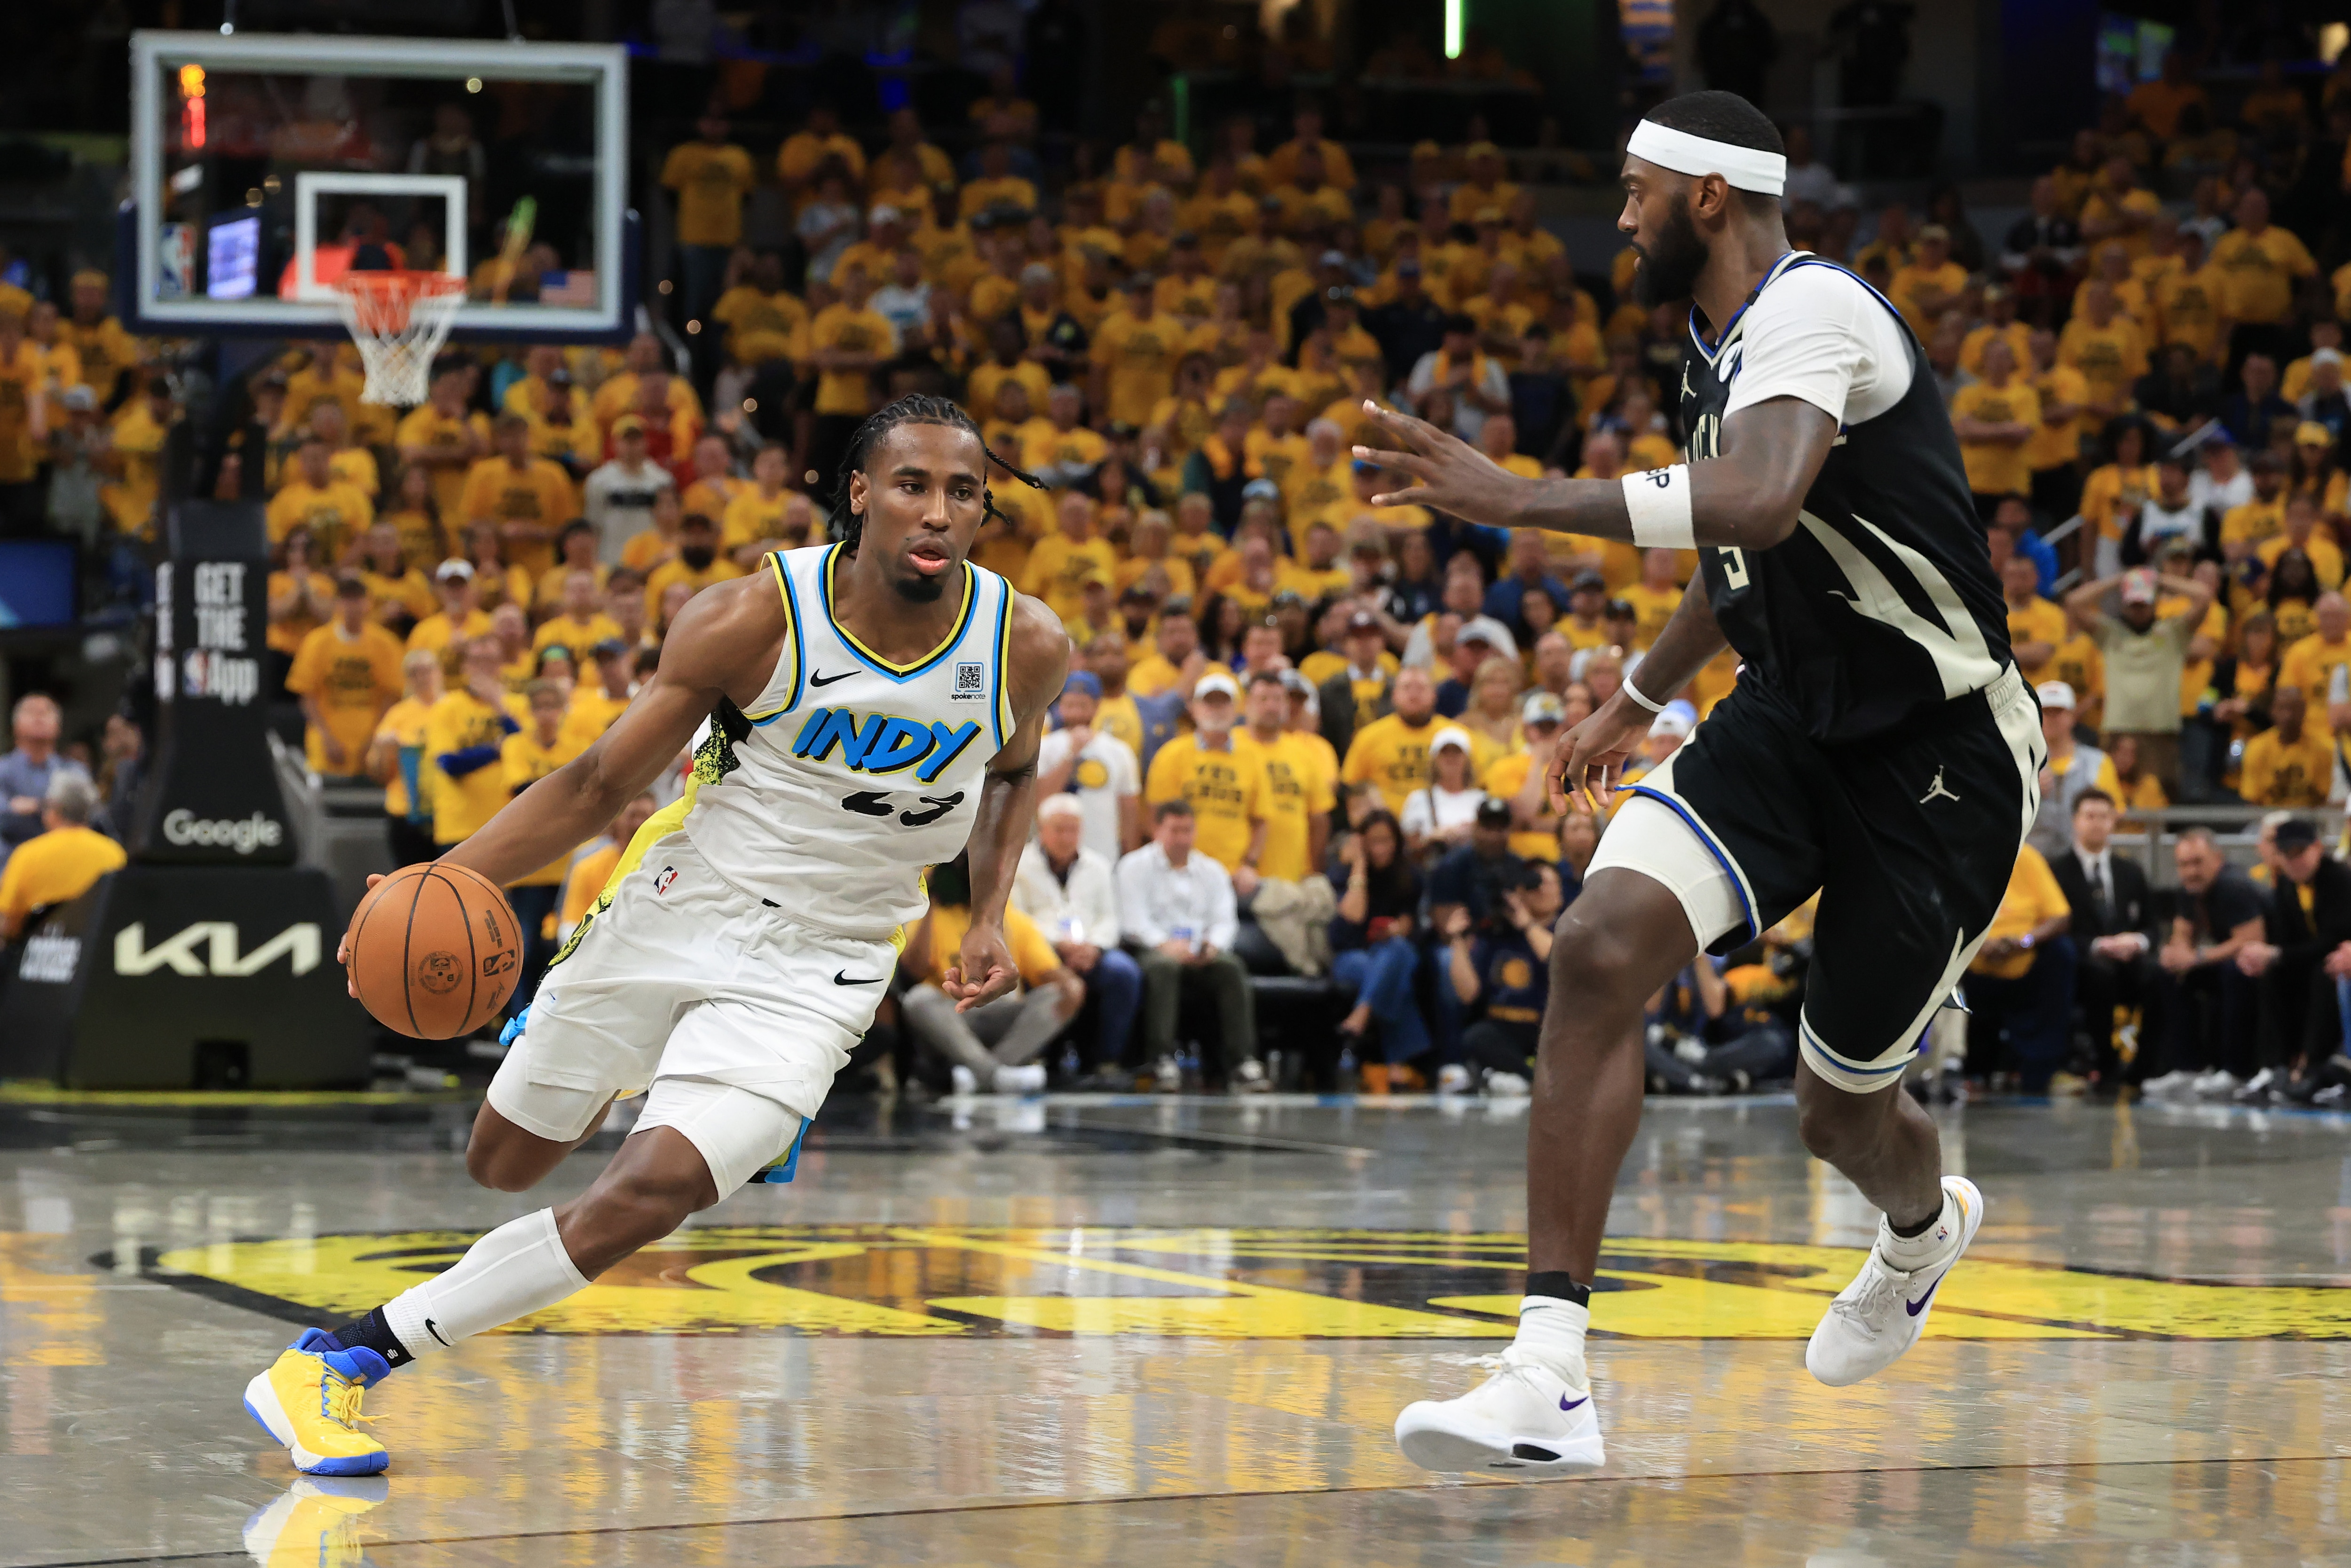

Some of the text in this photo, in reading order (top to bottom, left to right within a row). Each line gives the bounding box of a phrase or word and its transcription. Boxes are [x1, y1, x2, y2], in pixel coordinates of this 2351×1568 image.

[194, 561, 247, 604] GET
[193, 606, 248, 649] THE
[790, 706, 984, 785] INDY
[163, 808, 283, 854] Google
[113, 921, 322, 977] KIA
